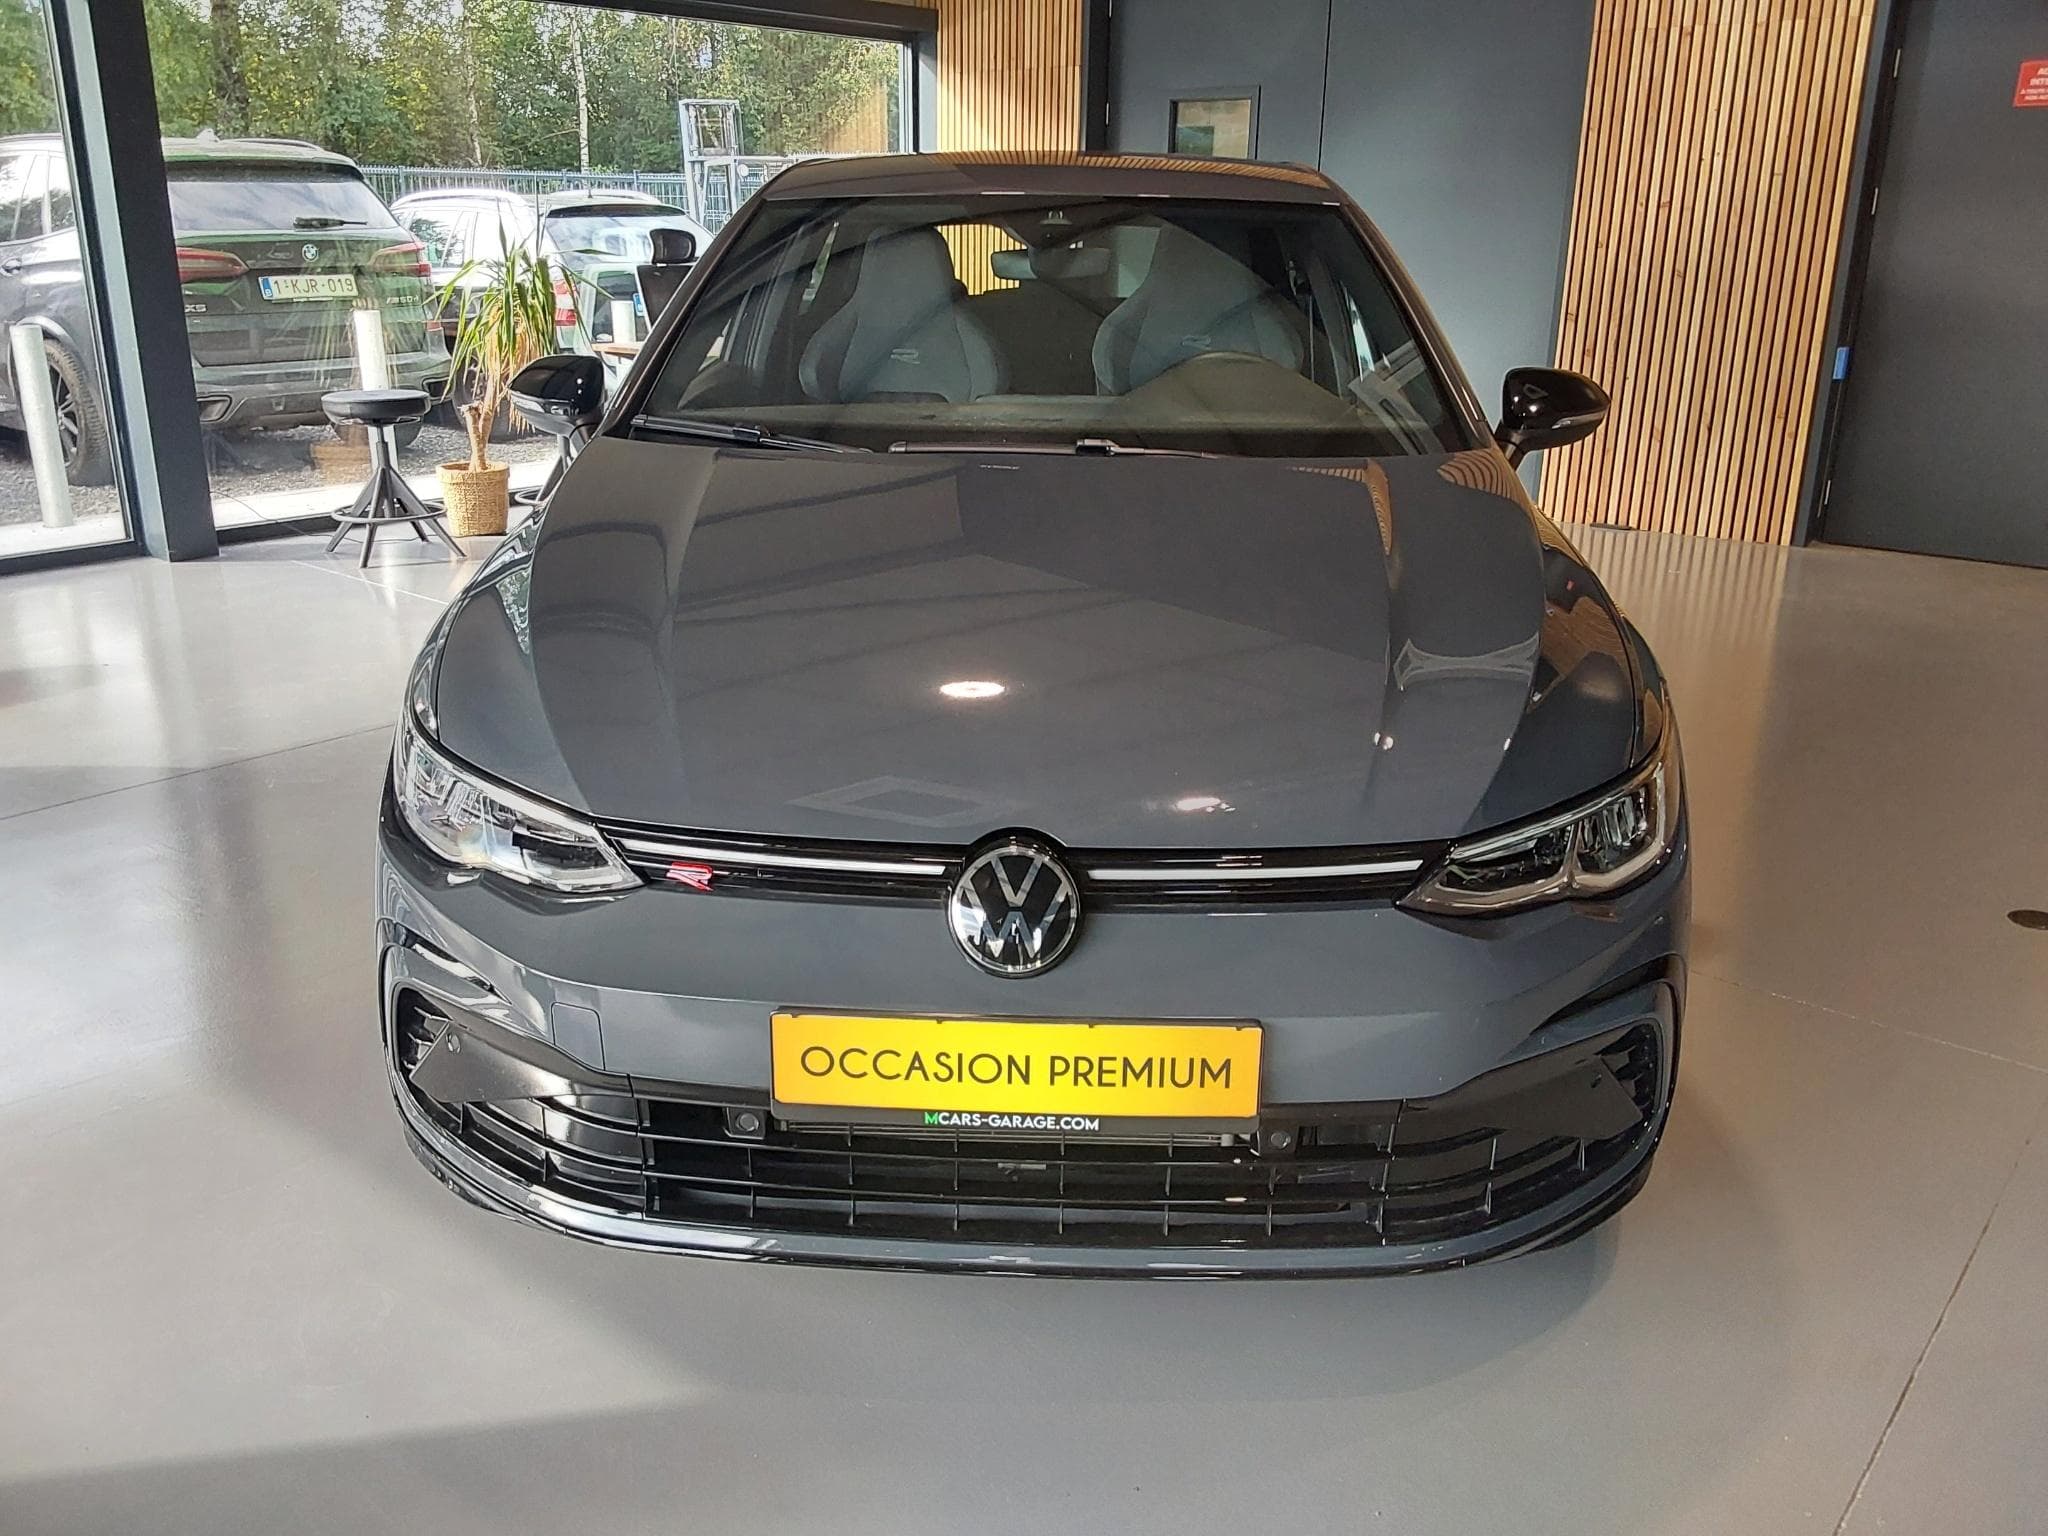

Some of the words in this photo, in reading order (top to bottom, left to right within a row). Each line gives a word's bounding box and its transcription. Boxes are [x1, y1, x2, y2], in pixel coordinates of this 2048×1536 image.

[801, 1046, 1031, 1086] OCCASION
[1050, 1055, 1232, 1089] PREMIUM
[924, 1111, 1100, 1131] MCARS-GARAGE.COM
